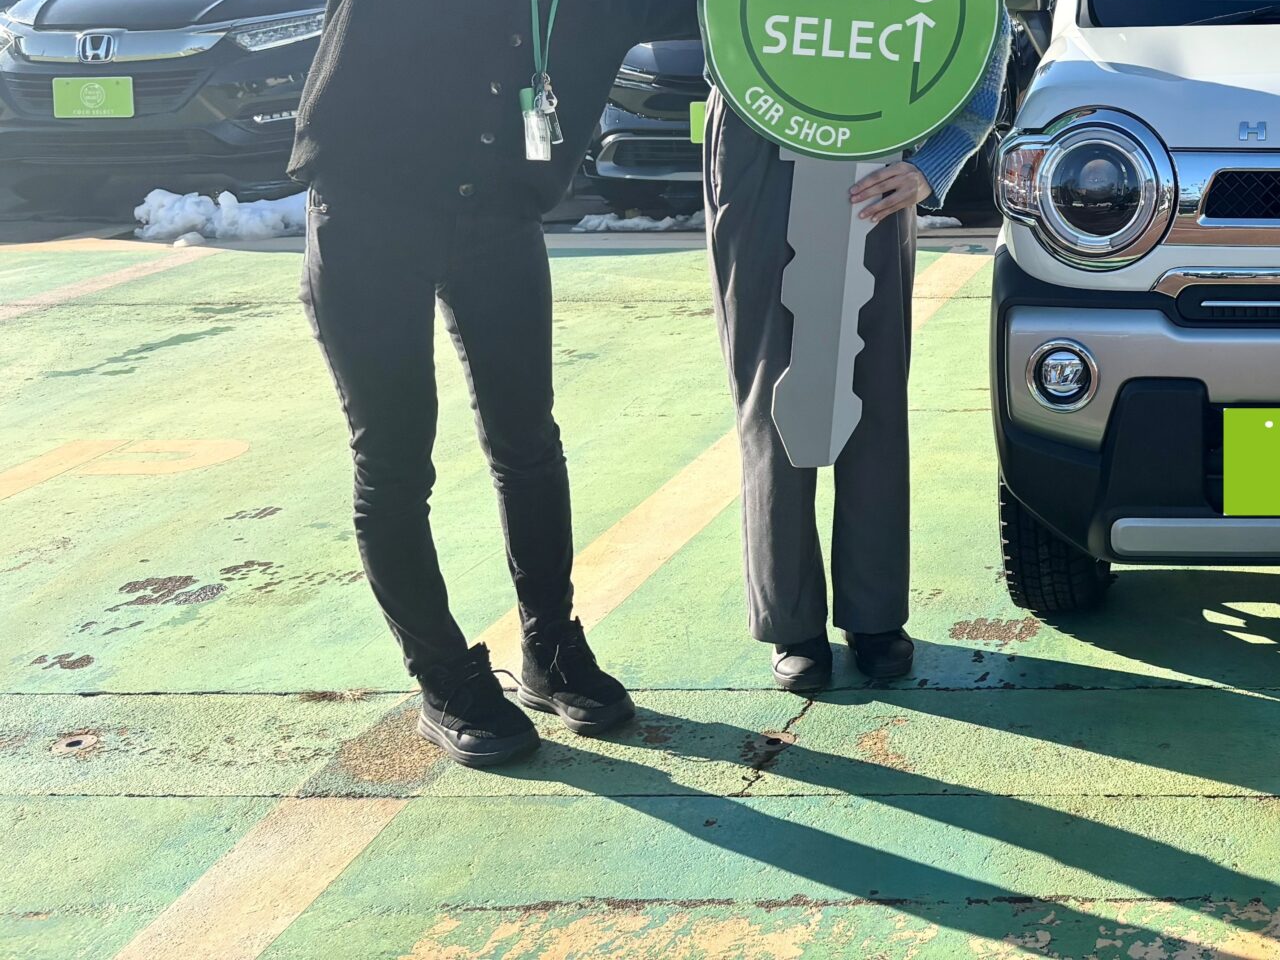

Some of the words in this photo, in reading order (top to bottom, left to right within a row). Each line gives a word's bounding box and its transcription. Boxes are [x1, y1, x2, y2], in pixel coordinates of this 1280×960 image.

[763, 12, 937, 64] SELECT
[745, 86, 785, 126] CAR
[785, 116, 851, 148] SHOP
